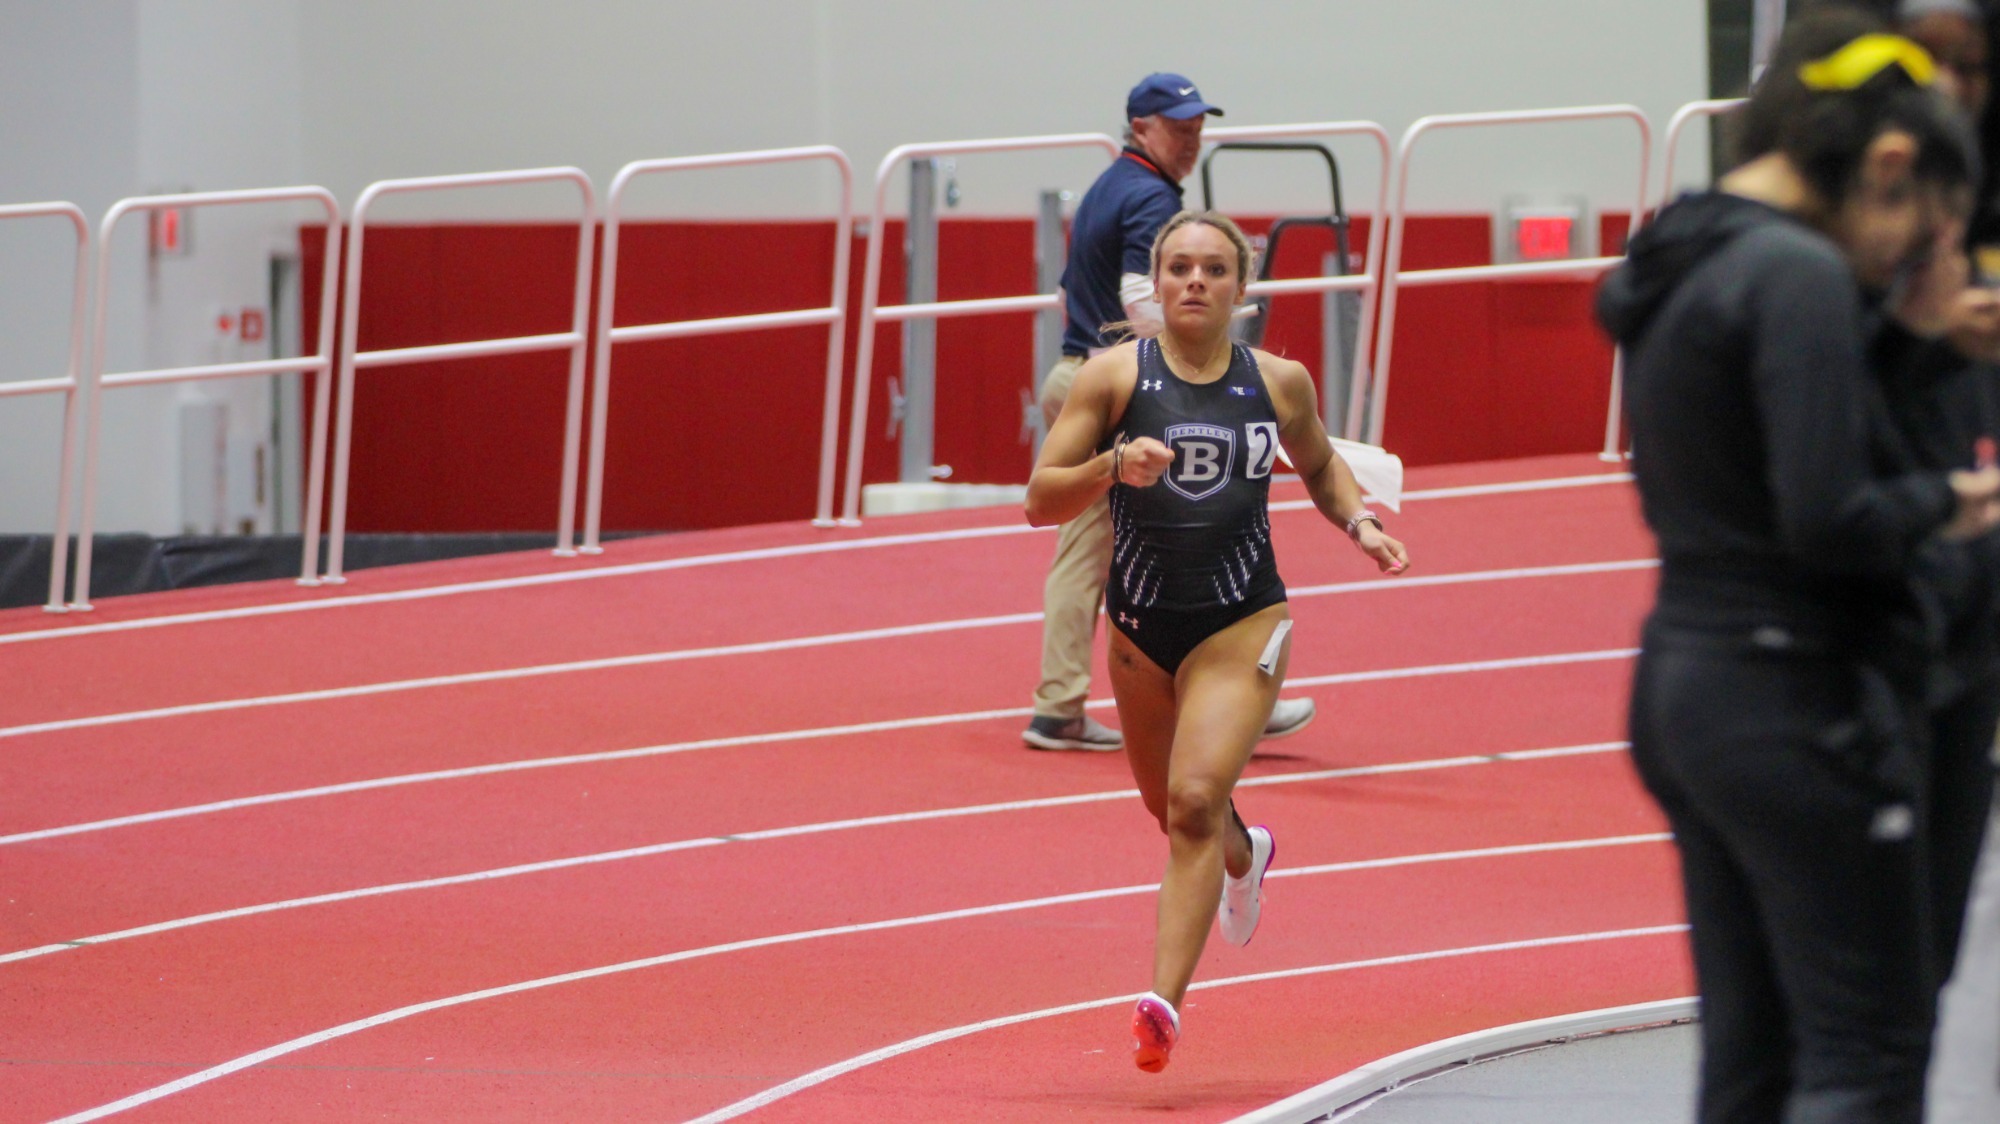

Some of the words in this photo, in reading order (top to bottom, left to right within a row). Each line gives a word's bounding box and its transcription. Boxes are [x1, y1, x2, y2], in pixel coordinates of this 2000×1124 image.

[1170, 427, 1231, 439] BENTLEY
[1253, 425, 1273, 475] 2
[1177, 441, 1220, 482] B
